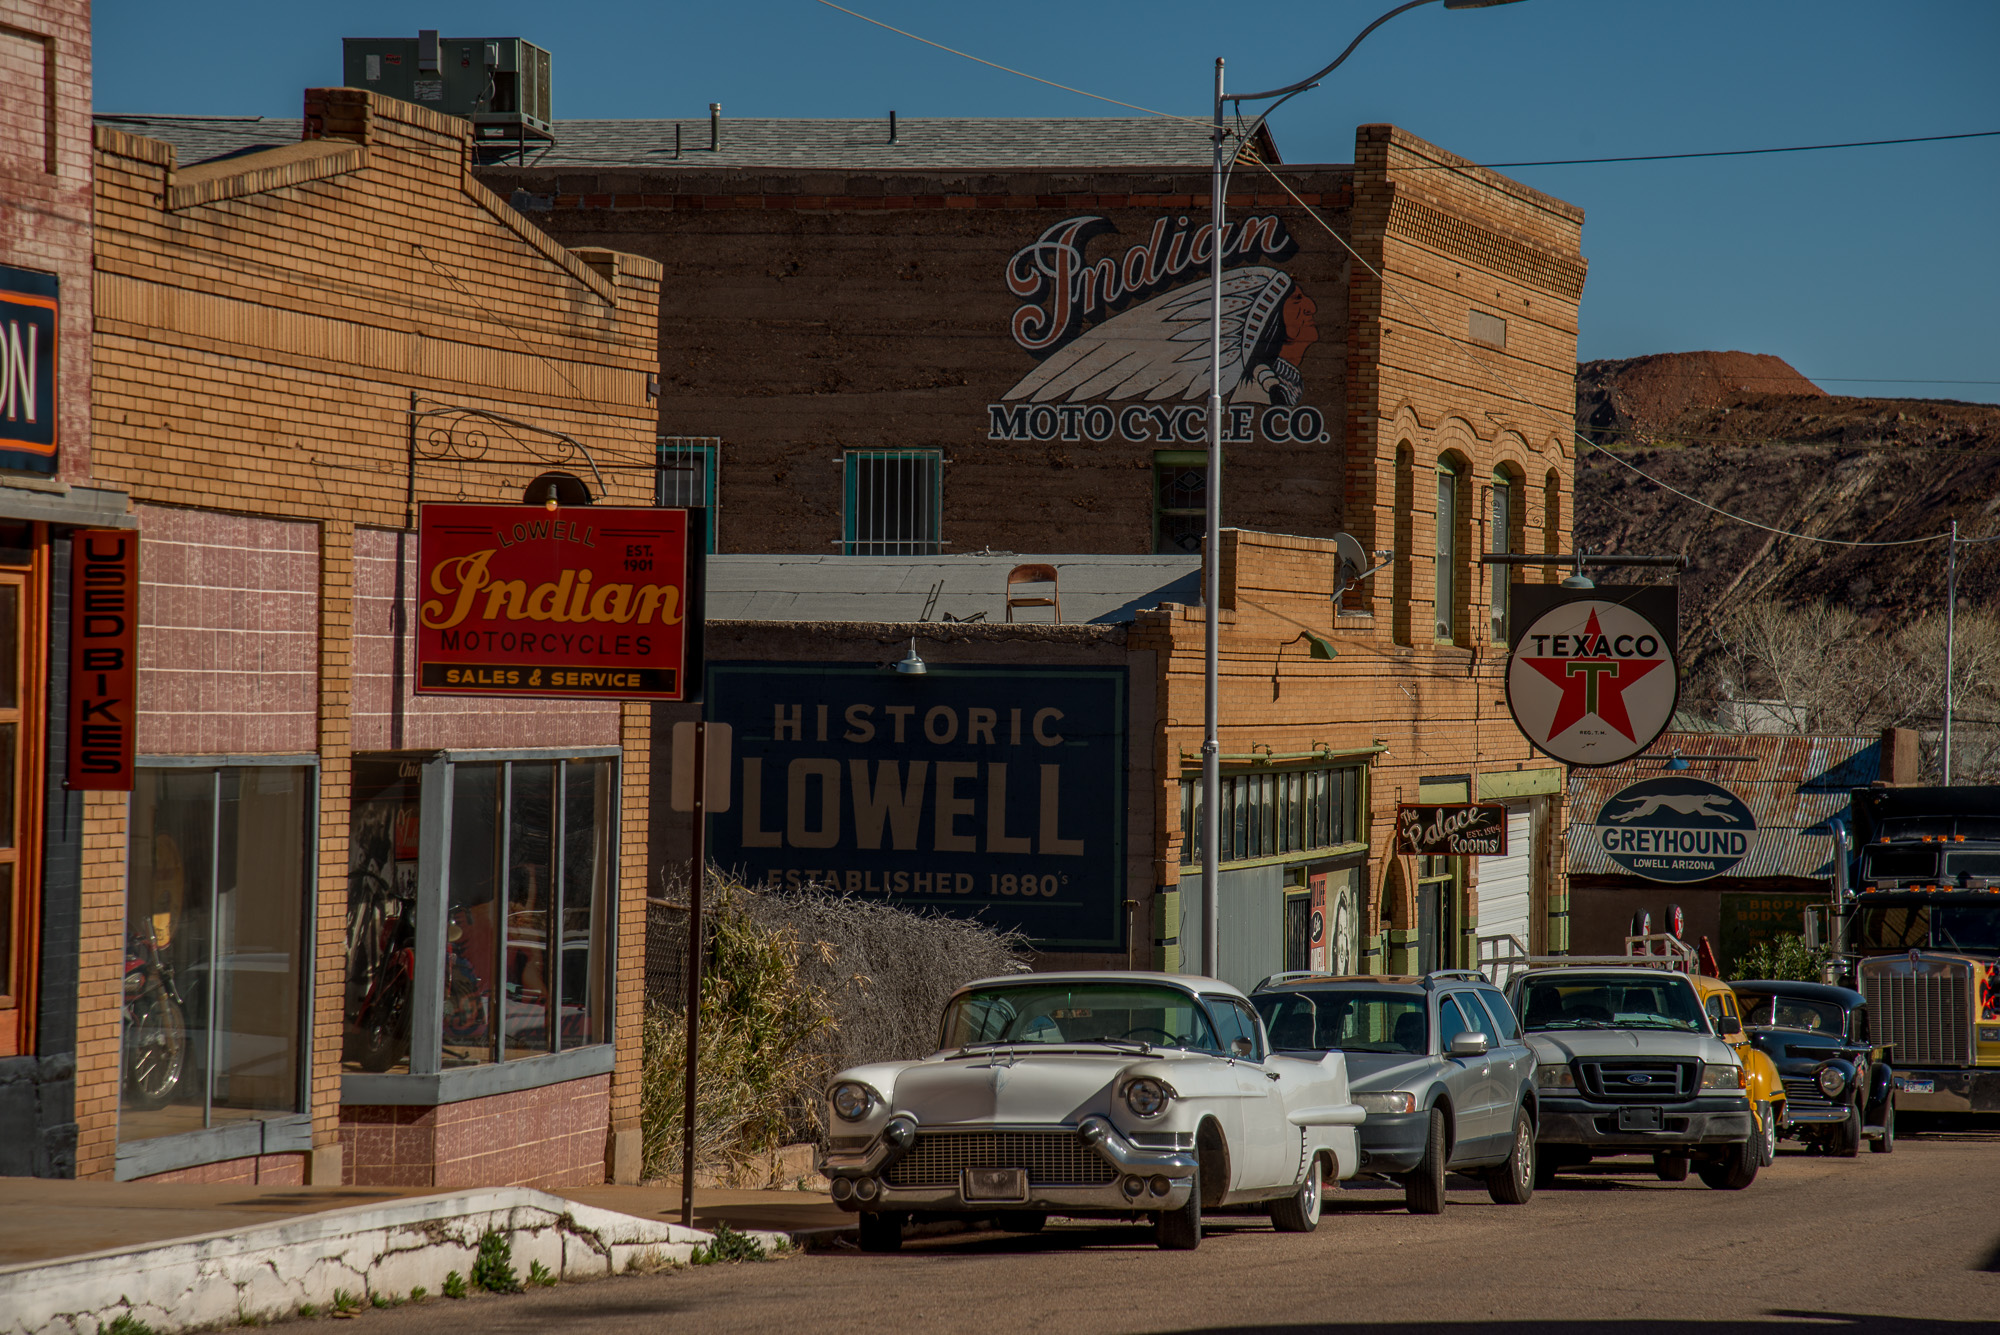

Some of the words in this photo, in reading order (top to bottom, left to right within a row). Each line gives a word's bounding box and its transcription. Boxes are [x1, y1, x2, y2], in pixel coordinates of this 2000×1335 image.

[1005, 214, 1291, 351] Indian
[1261, 405, 1331, 443] CO.
[497, 519, 596, 549] LOWELL
[626, 545, 654, 557] EST.
[624, 559, 653, 572] 1901
[84, 539, 126, 638] USED
[420, 548, 684, 630] Indian
[441, 630, 651, 656] MOTORCYCLES
[1531, 634, 1659, 658] TEXACO
[446, 669, 520, 685] SALES
[528, 668, 542, 687] &
[551, 671, 641, 688] SERVICE
[1565, 661, 1620, 715] T
[81, 648, 125, 774] BIKES
[773, 703, 1066, 747] HISTORIC
[741, 757, 1085, 857] LOWELL
[1400, 808, 1420, 827] The
[1402, 806, 1489, 855] Palace
[1447, 833, 1499, 855] Rooms
[1602, 828, 1748, 855] GREYHOUND
[1633, 858, 1669, 870] LOWELL
[1671, 859, 1716, 871] ARIZONA
[767, 869, 975, 895] ESTABLISHED
[1736, 911, 1786, 922] BODY
